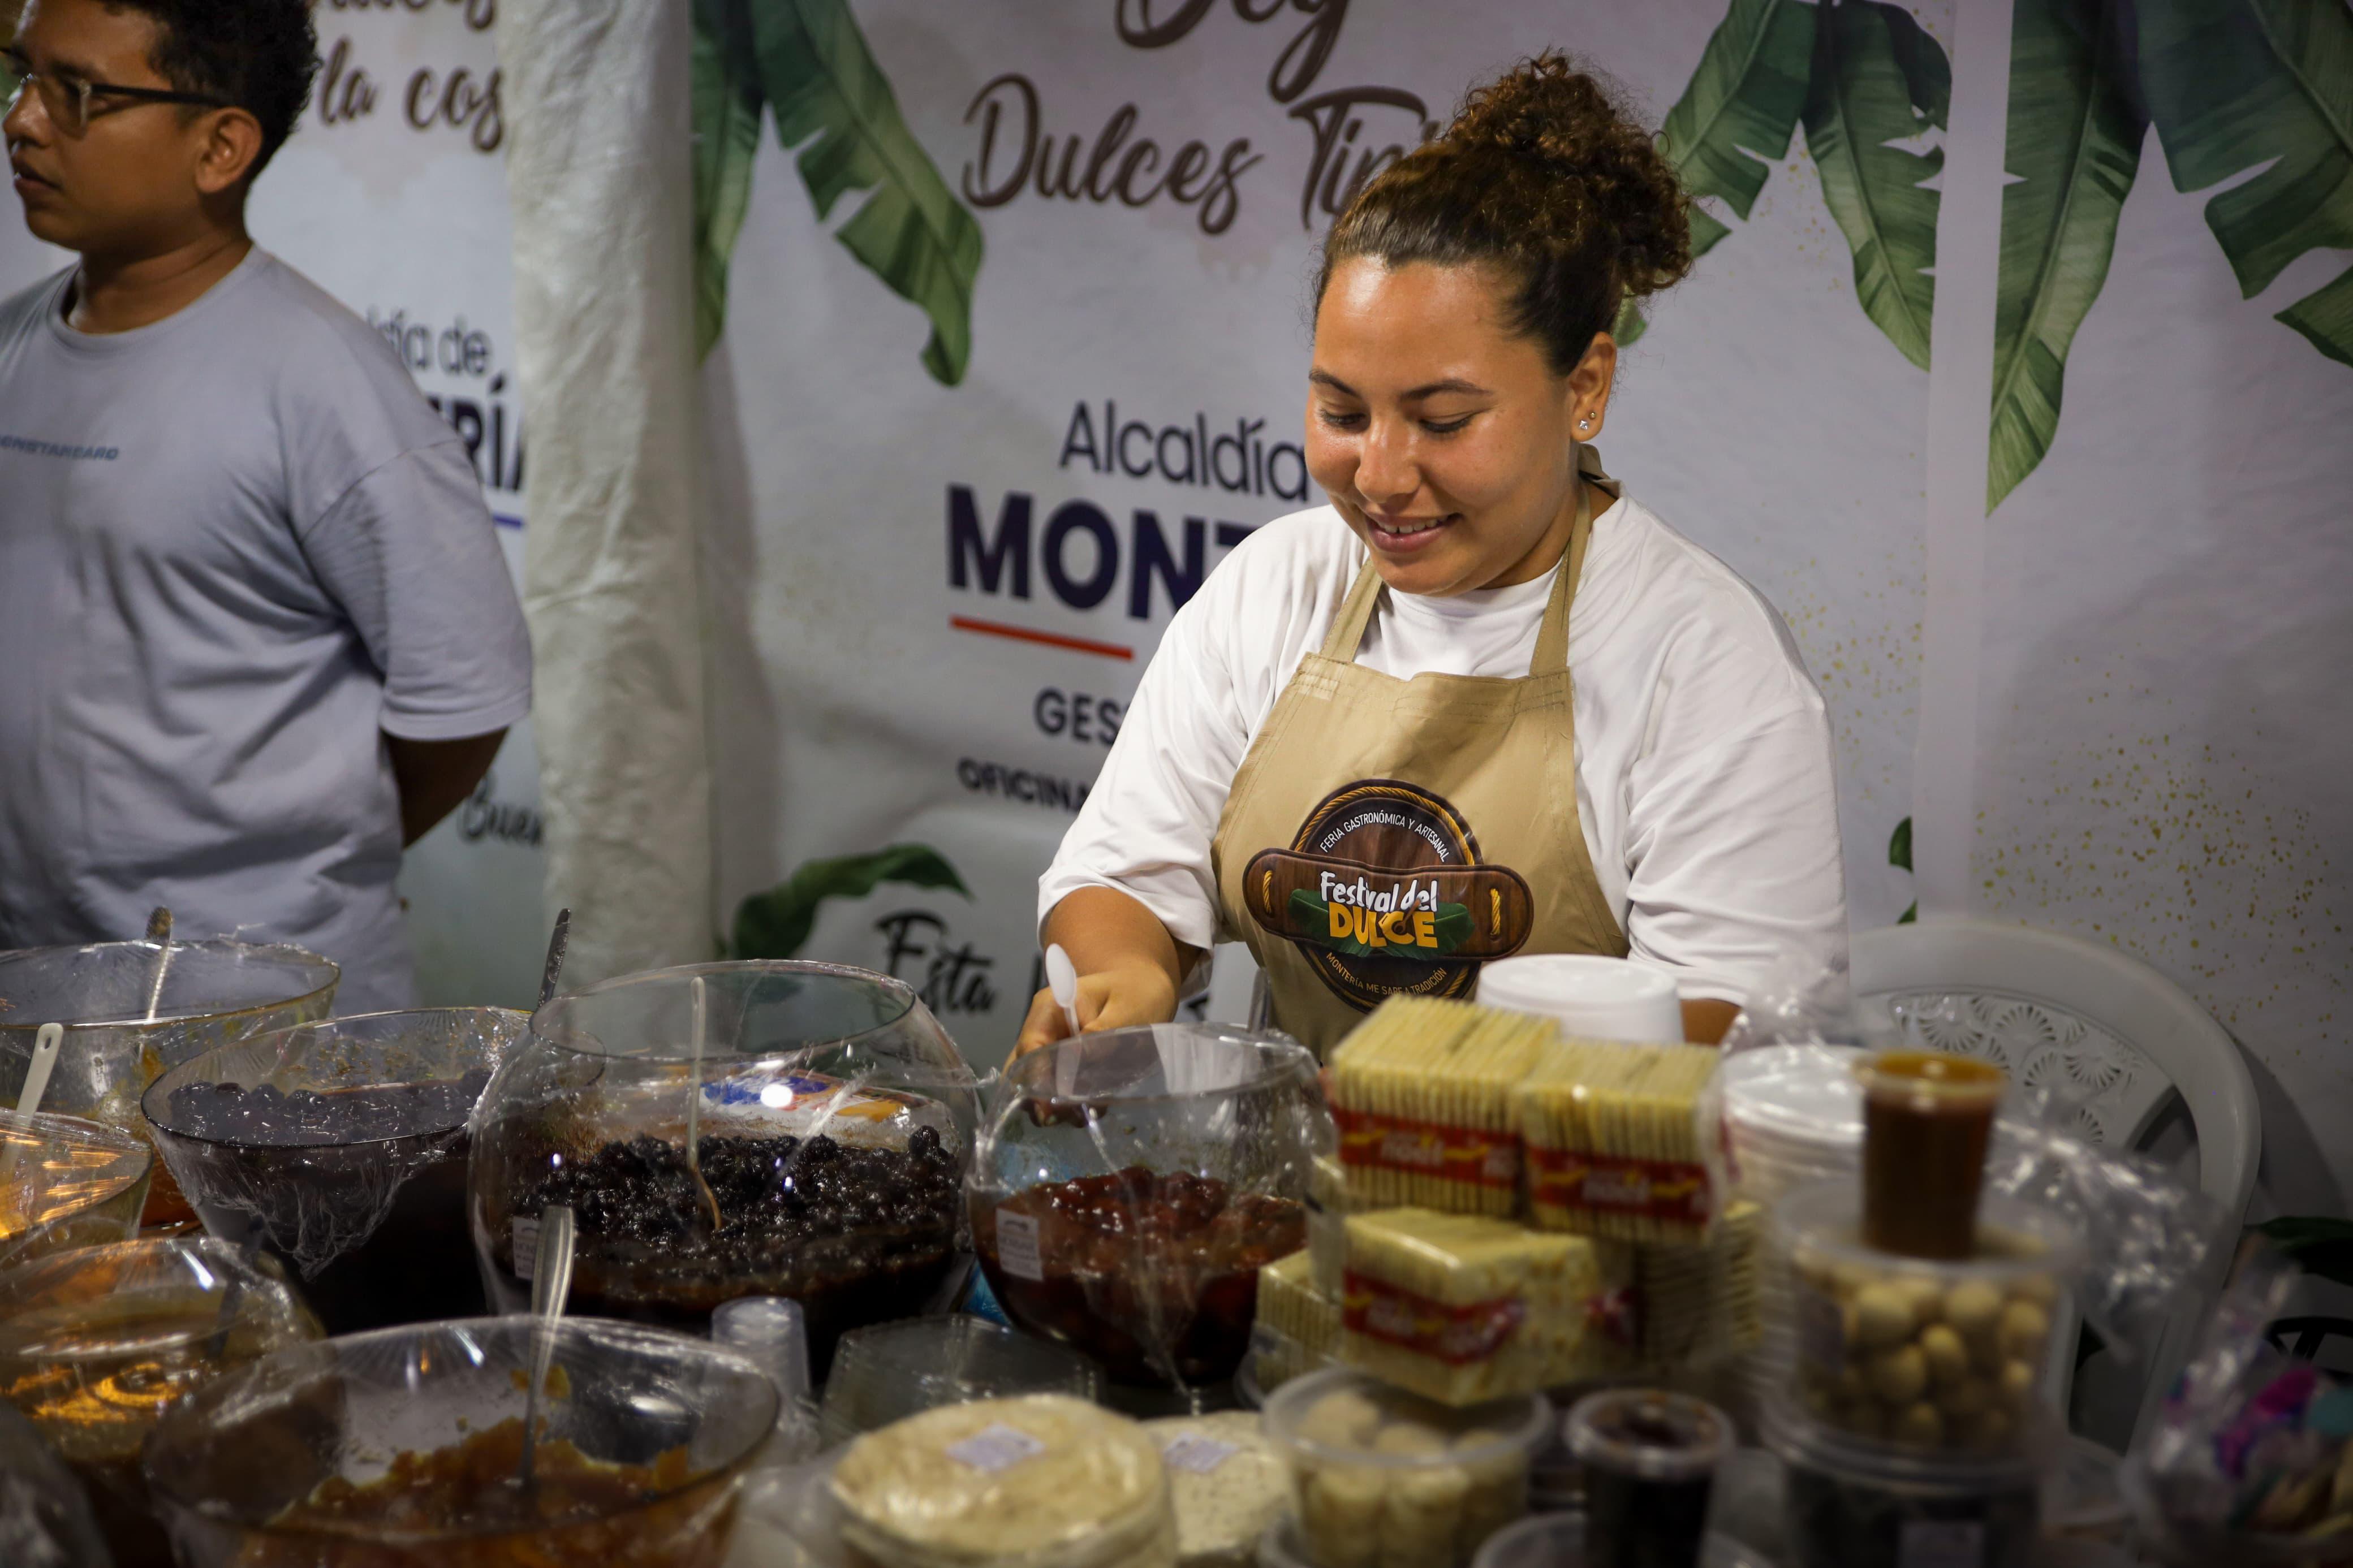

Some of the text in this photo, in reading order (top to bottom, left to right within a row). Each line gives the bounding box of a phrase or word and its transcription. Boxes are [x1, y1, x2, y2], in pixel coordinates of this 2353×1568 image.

[320, 36, 378, 126] la
[963, 74, 1443, 235] Dulces Tin
[438, 318, 491, 375] de
[1059, 399, 1309, 502] Alcaldía
[947, 482, 1262, 621] MON
[1035, 686, 1130, 748] GES
[1320, 809, 1450, 863] FERIA GASTRONÓMICA Y ARTESANAL
[1329, 900, 1438, 948] DULCE
[1400, 879, 1438, 912] del
[1326, 952, 1364, 990] MONTERÍA
[1365, 982, 1380, 994] ME
[1410, 967, 1448, 996] TRADICIÓN
